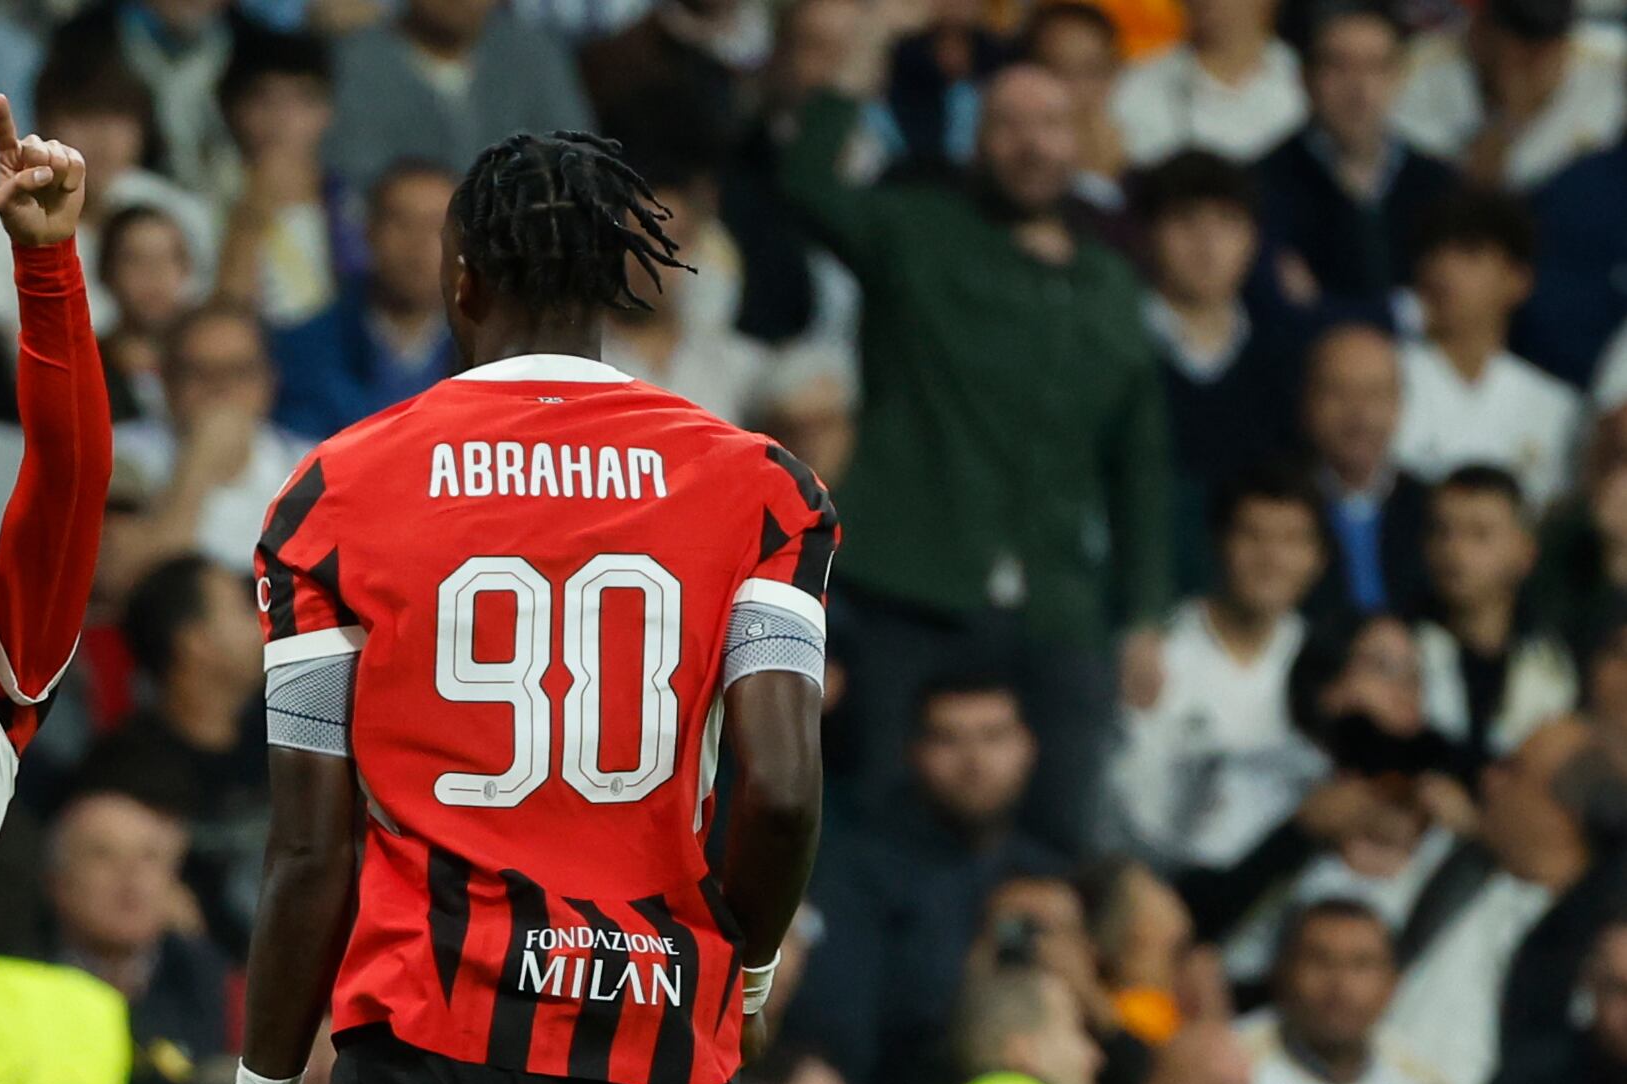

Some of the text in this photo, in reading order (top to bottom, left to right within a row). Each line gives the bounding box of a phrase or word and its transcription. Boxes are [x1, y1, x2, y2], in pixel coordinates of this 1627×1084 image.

[429, 441, 666, 499] ABRAHAM
[433, 552, 682, 808] 90
[525, 926, 680, 956] FONDAZIONE
[518, 950, 682, 1007] MILAN
